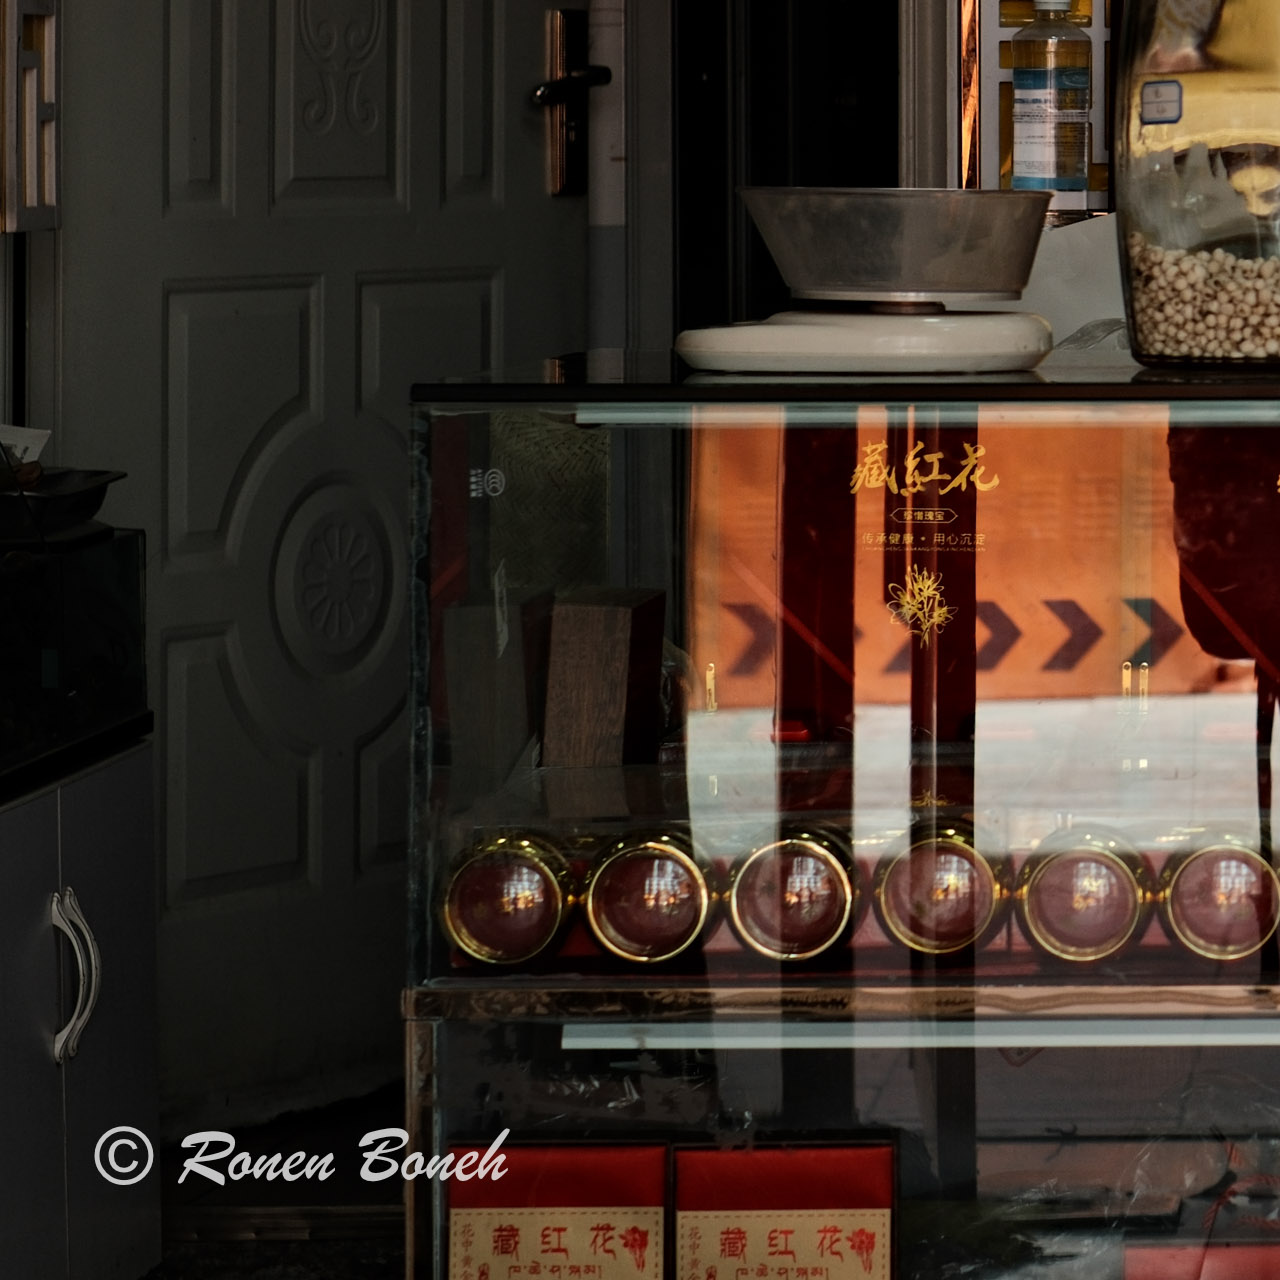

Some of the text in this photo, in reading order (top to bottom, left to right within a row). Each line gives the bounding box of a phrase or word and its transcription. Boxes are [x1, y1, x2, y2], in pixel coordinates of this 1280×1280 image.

[850, 439, 1000, 497] 藏紅花
[862, 533, 986, 545] 传承健康 用心沉淀
[492, 1223, 616, 1261] 藏红花
[719, 1226, 844, 1263] 藏红花
